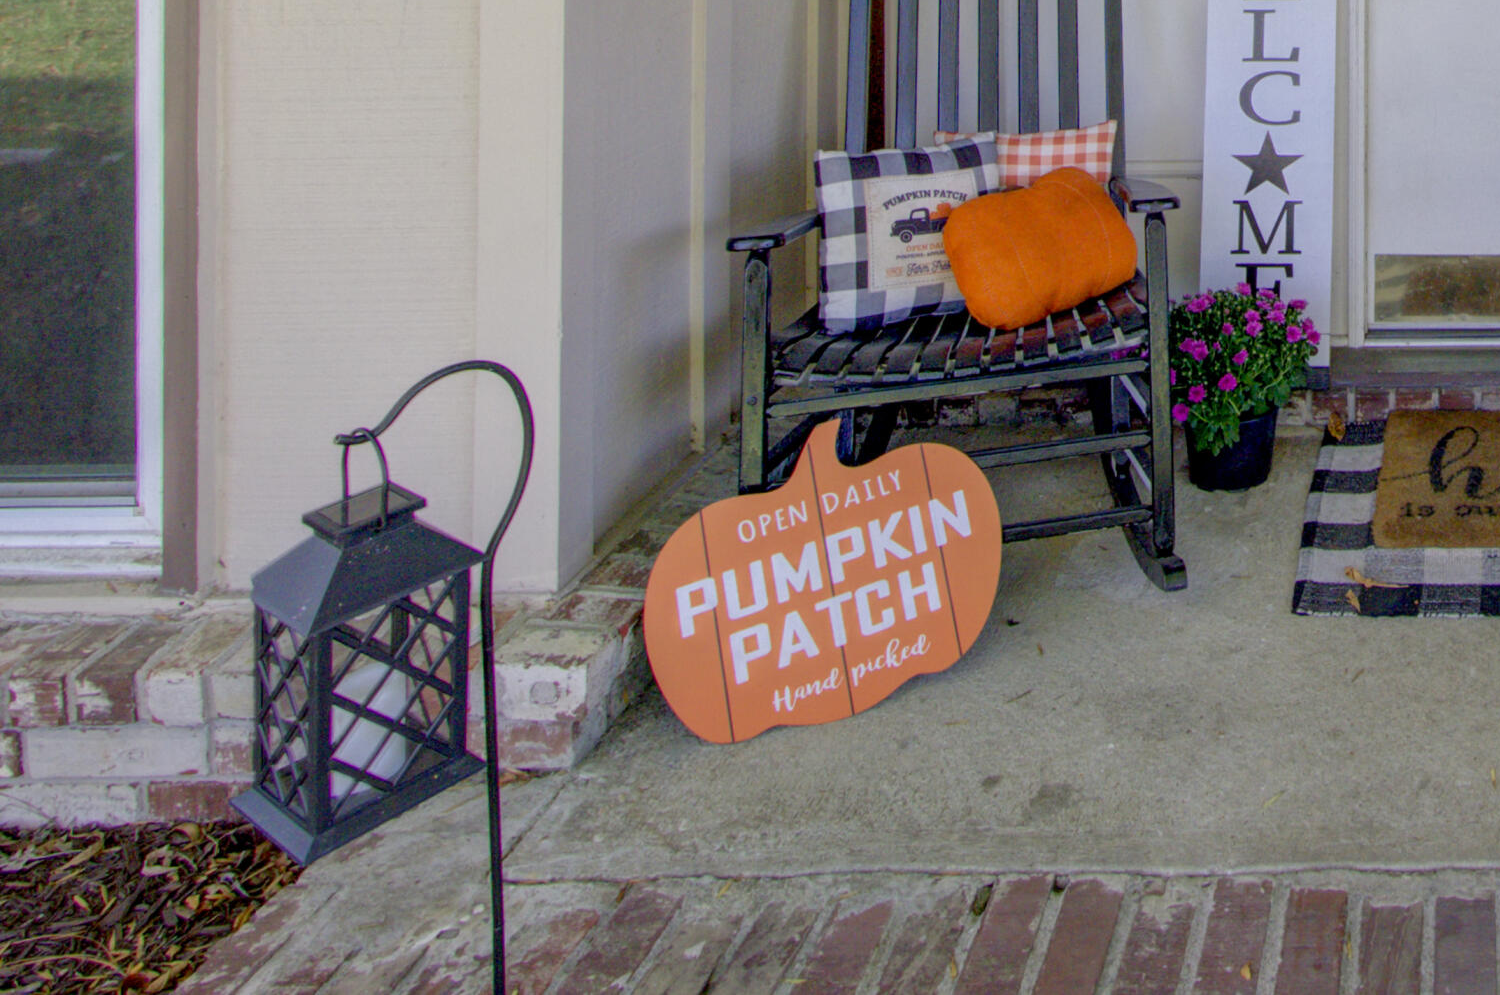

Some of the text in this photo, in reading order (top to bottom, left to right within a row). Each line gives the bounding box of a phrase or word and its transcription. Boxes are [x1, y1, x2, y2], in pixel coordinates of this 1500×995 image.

[882, 189, 968, 211] PUMPKIN PATCH
[737, 469, 902, 544] OPEN DAILY
[1399, 501, 1435, 517] is
[675, 489, 973, 639] PUMPKIN
[729, 561, 942, 686] PATCH
[772, 634, 932, 713] Hand picked
